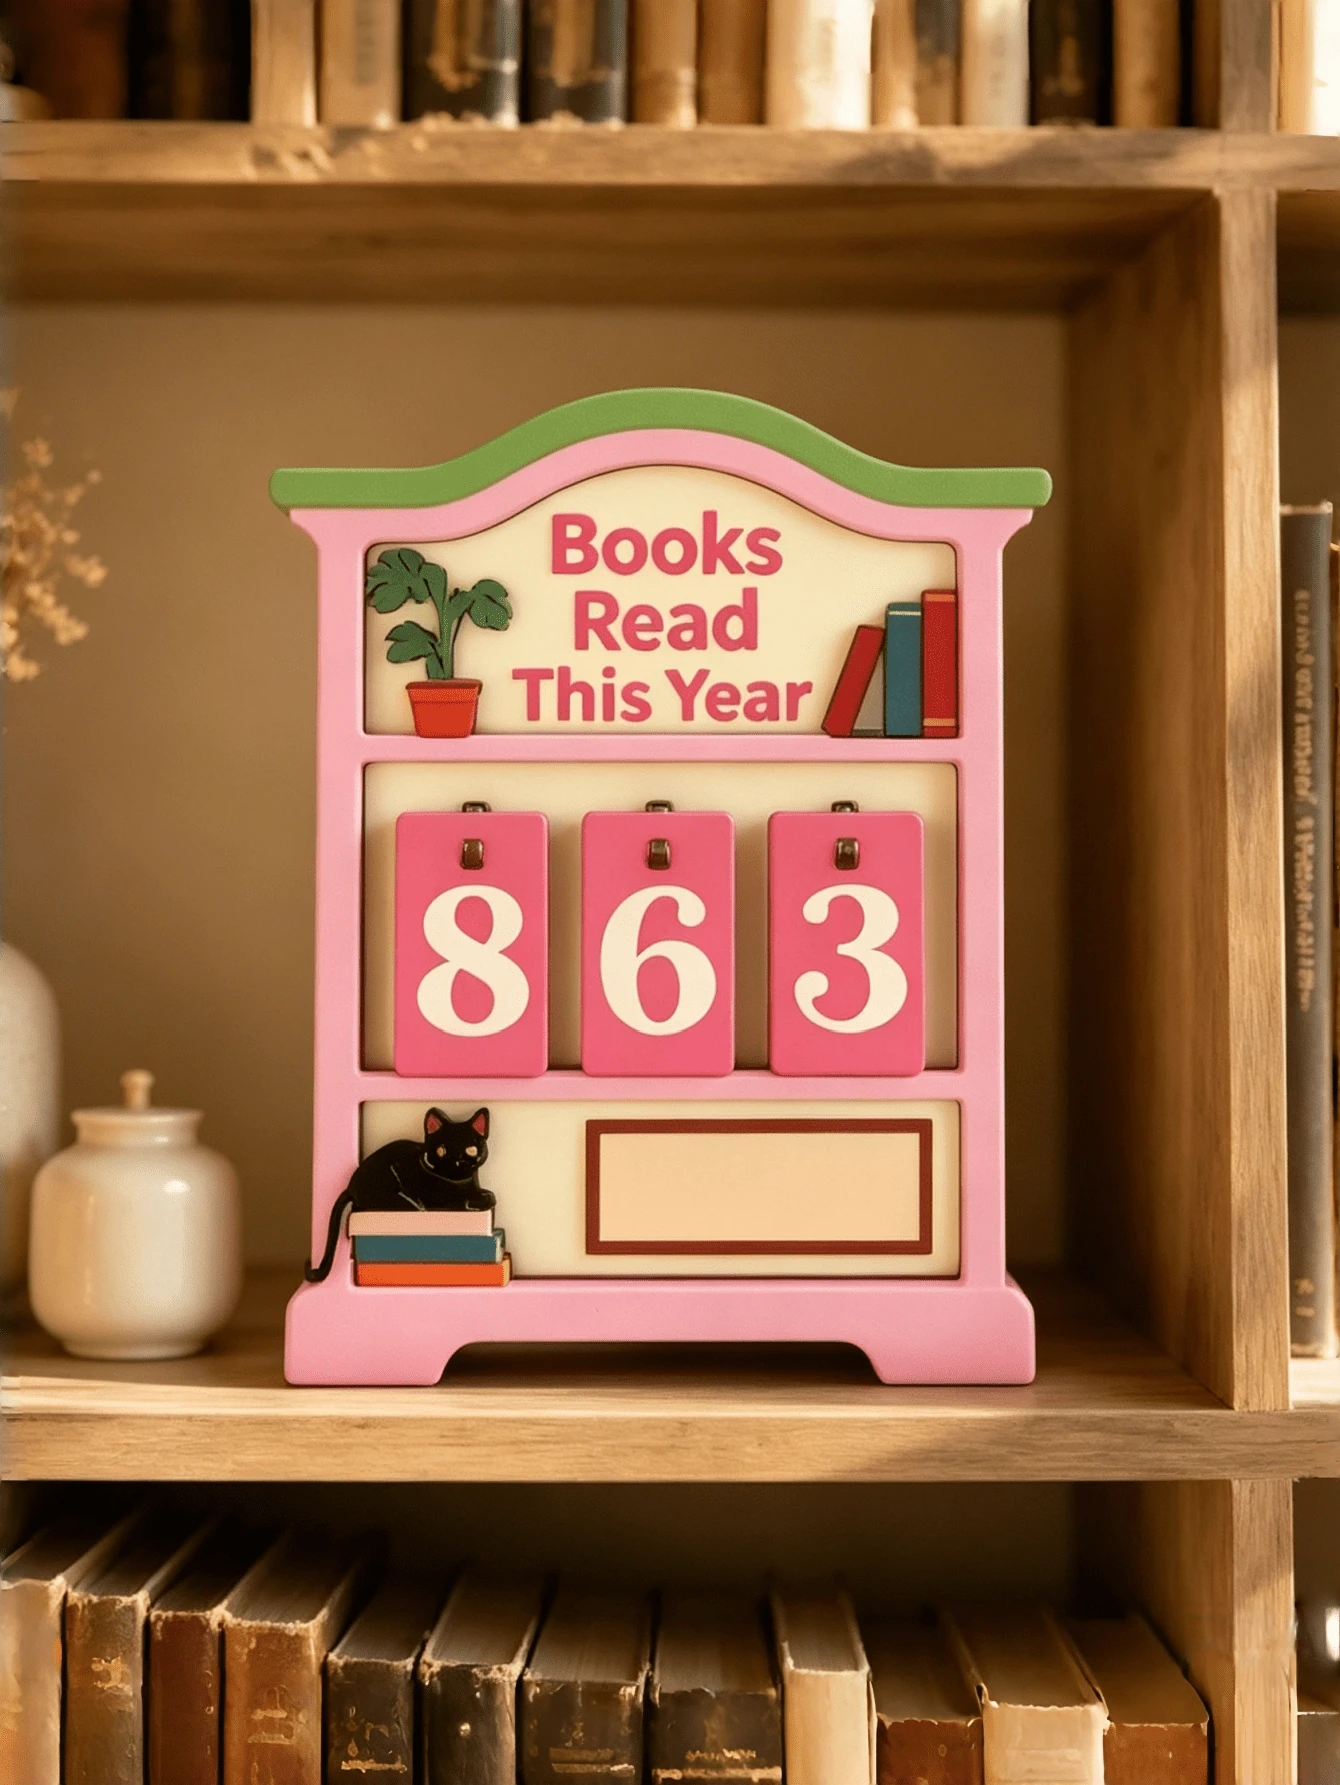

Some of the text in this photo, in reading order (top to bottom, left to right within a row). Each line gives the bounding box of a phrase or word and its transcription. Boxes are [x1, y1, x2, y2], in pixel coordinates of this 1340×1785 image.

[551, 510, 783, 577] Books
[573, 588, 758, 652] Read
[511, 666, 814, 723] This Year
[417, 884, 908, 1037] 8 6 3
